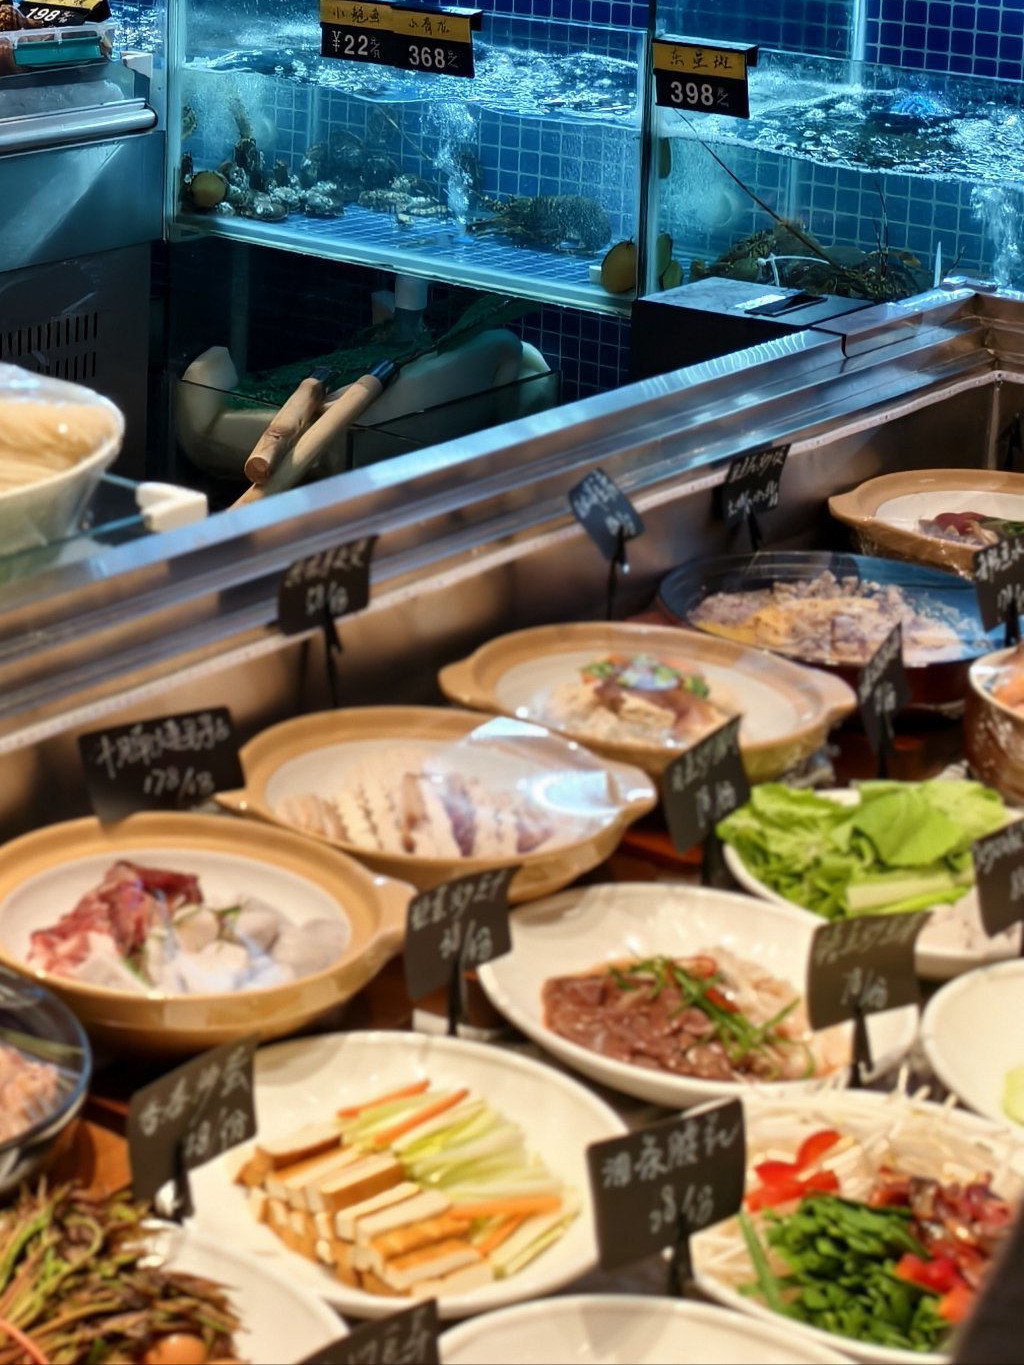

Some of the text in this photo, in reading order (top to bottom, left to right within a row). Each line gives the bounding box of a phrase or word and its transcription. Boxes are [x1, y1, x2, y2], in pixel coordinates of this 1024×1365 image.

[26, 7, 60, 21] 198
[408, 45, 445, 68] 368
[670, 81, 714, 105] 398
